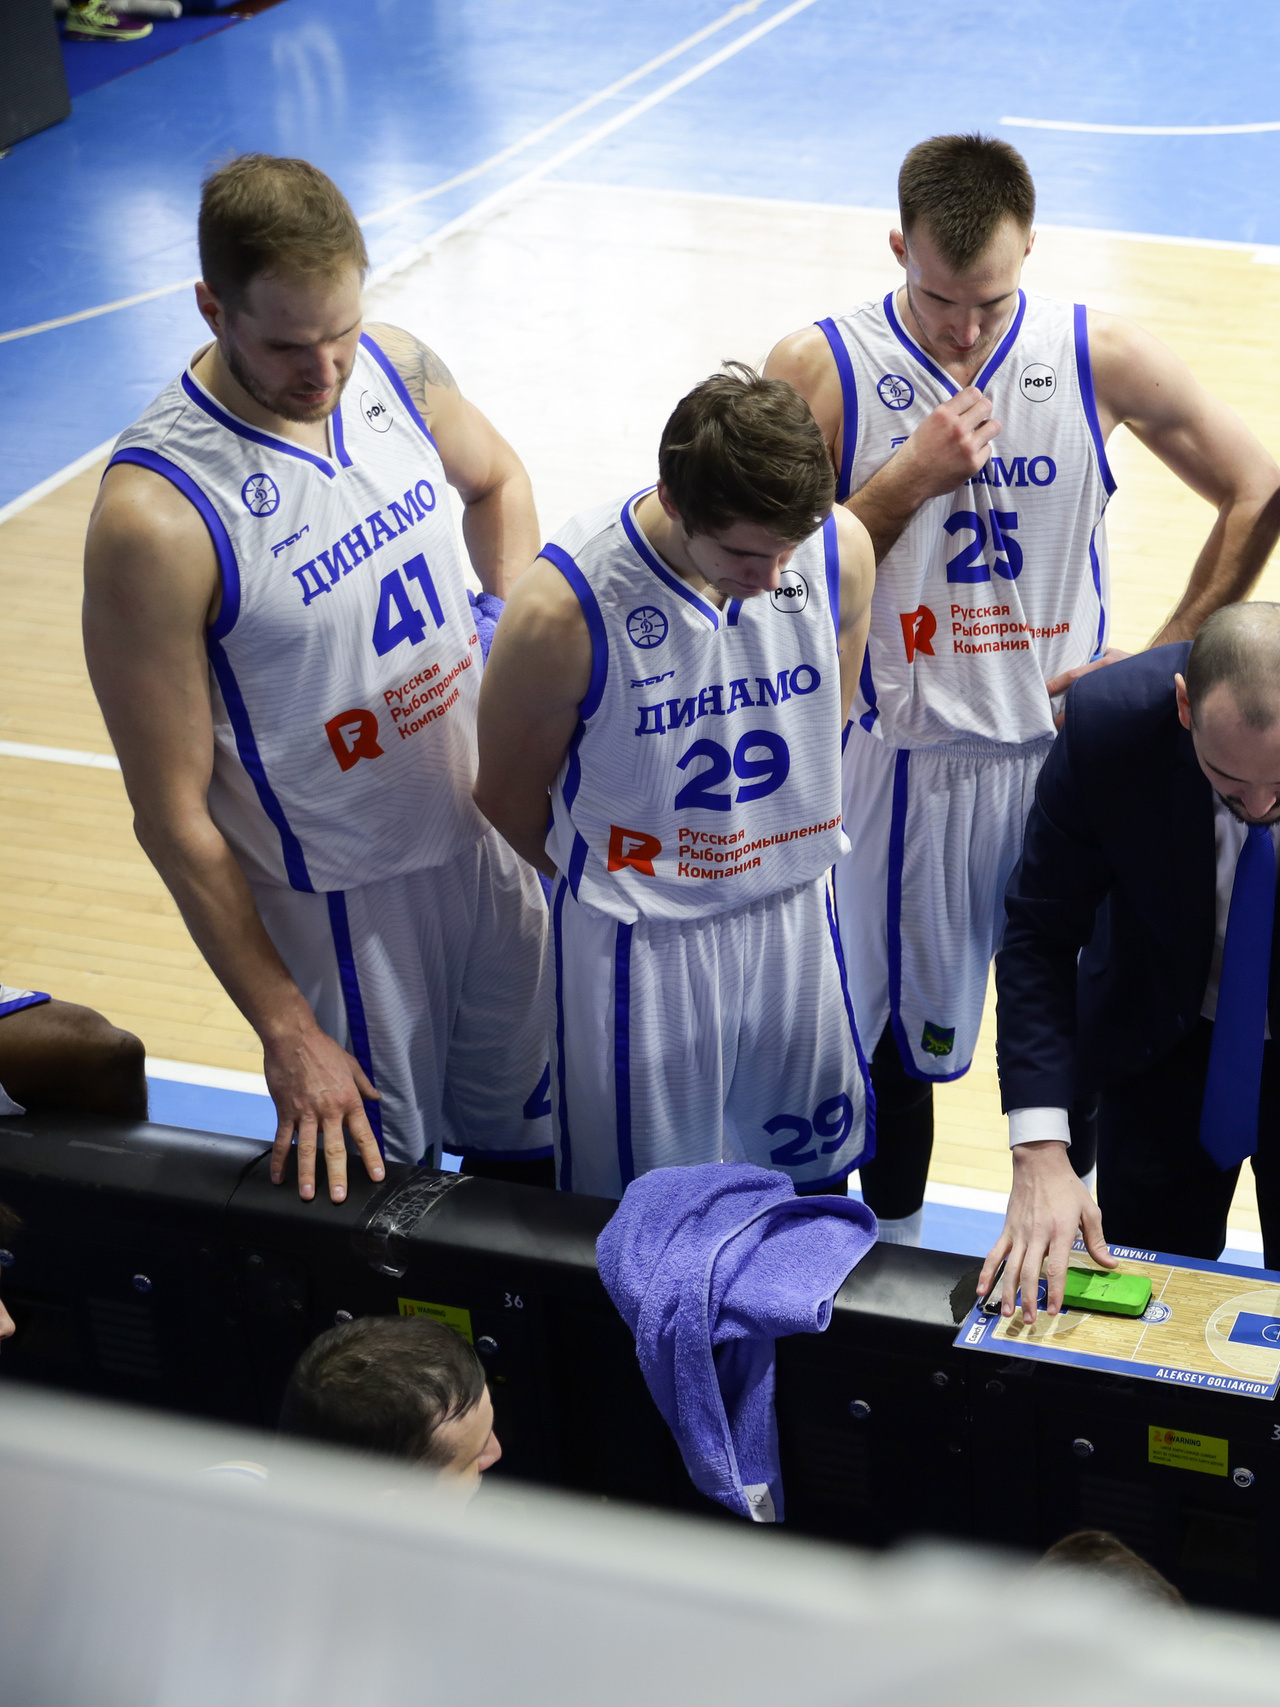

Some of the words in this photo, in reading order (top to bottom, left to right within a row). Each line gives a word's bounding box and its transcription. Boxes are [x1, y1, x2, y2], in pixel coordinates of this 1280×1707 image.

[1024, 376, 1053, 388] РФБ
[291, 479, 436, 607] ДИНАМО
[943, 508, 1024, 583] 25
[372, 552, 445, 658] 41
[774, 584, 804, 600] РФБ
[951, 604, 1010, 621] Русская
[953, 639, 1030, 656] Компания
[383, 663, 440, 706] Русская
[635, 664, 821, 736] ДИНАМО
[398, 688, 460, 740] Компания
[674, 729, 790, 811] 29
[678, 828, 745, 846] Русская
[679, 814, 841, 863] Рыбопромышленная
[677, 856, 761, 880] Компания
[763, 1092, 854, 1167] 29
[1113, 1247, 1157, 1262] DYNAMO
[417, 1306, 446, 1317] WARNING
[504, 1292, 524, 1308] 36
[1156, 1368, 1206, 1383] ALEKSEY
[1207, 1377, 1269, 1394] GOLIAKHOV
